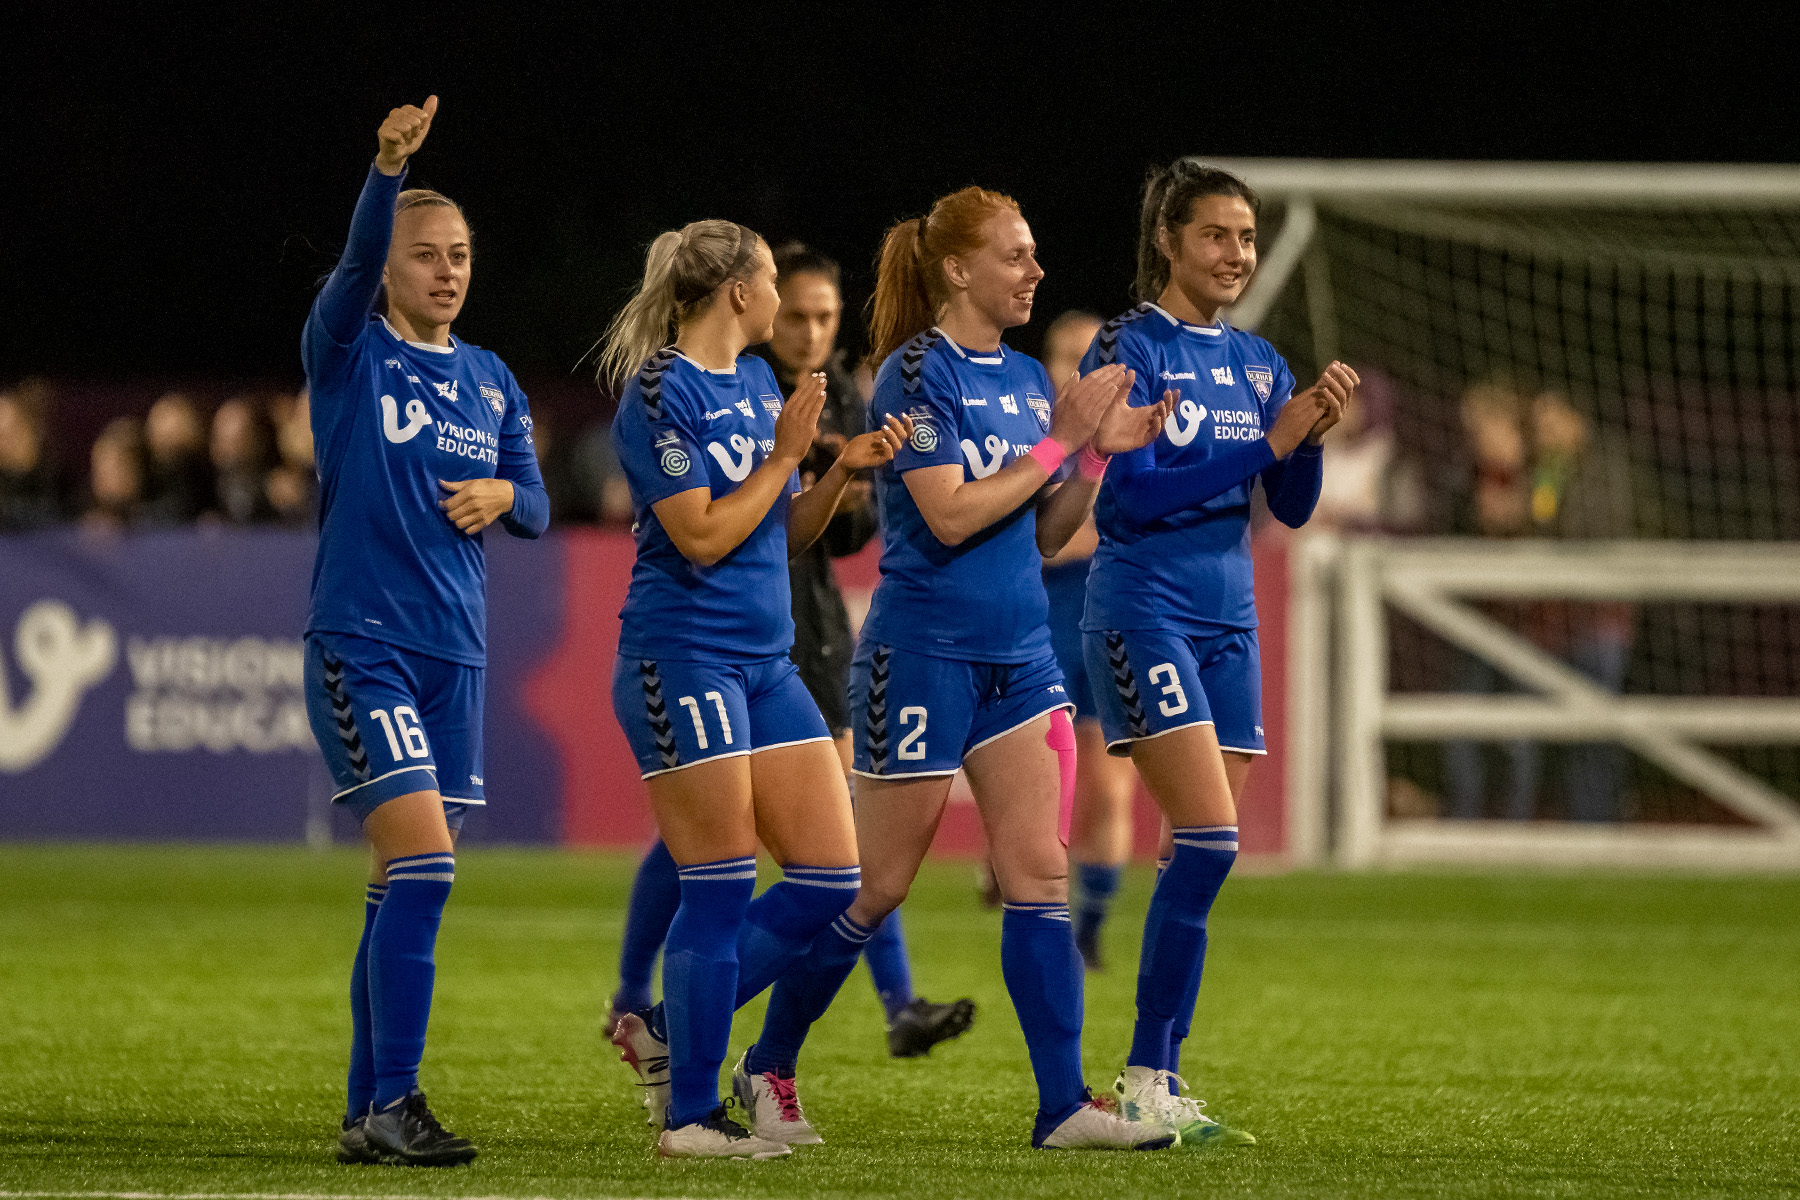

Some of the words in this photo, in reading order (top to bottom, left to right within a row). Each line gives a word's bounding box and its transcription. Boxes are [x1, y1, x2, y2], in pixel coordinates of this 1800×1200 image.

[436, 420, 486, 445] VISION
[1211, 410, 1253, 426] VISION
[1253, 412, 1261, 427] fo
[436, 436, 498, 466] EDUCATIO
[757, 439, 775, 452] VIS
[1012, 444, 1033, 457] VIS
[1148, 662, 1189, 718] 3
[369, 705, 430, 762] 16
[678, 691, 734, 750] 11
[897, 706, 928, 761] 2
